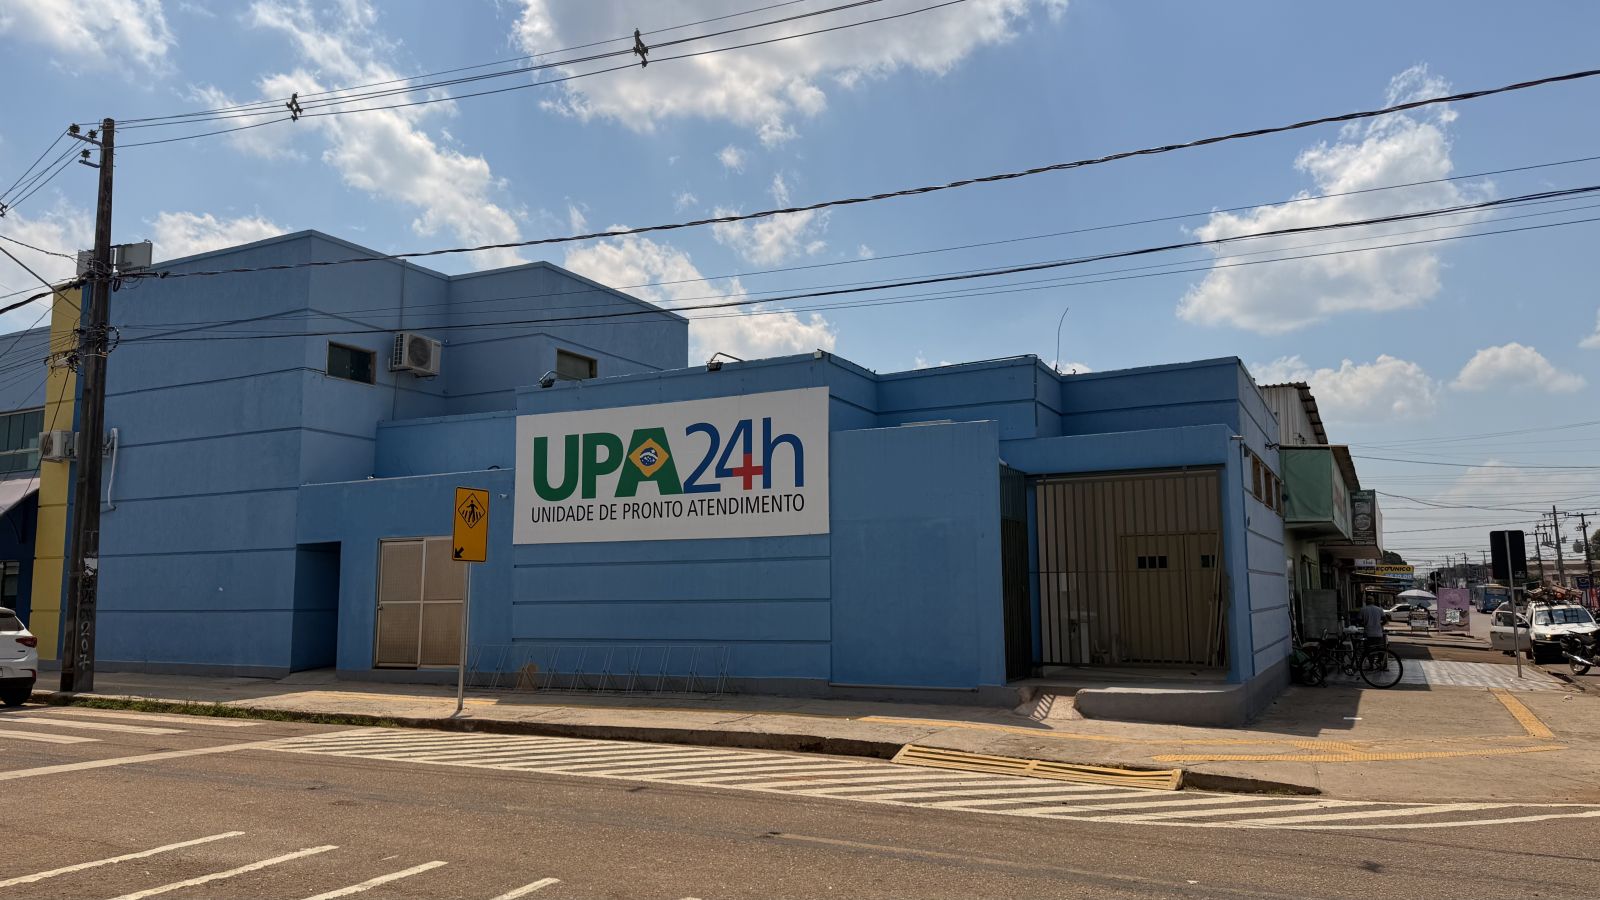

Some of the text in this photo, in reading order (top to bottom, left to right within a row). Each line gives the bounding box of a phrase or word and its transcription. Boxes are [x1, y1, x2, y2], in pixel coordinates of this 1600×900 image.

[533, 417, 804, 501] UPA 24h
[531, 493, 805, 523] UNIDADE DE PRONTO ATENDIMENTO
